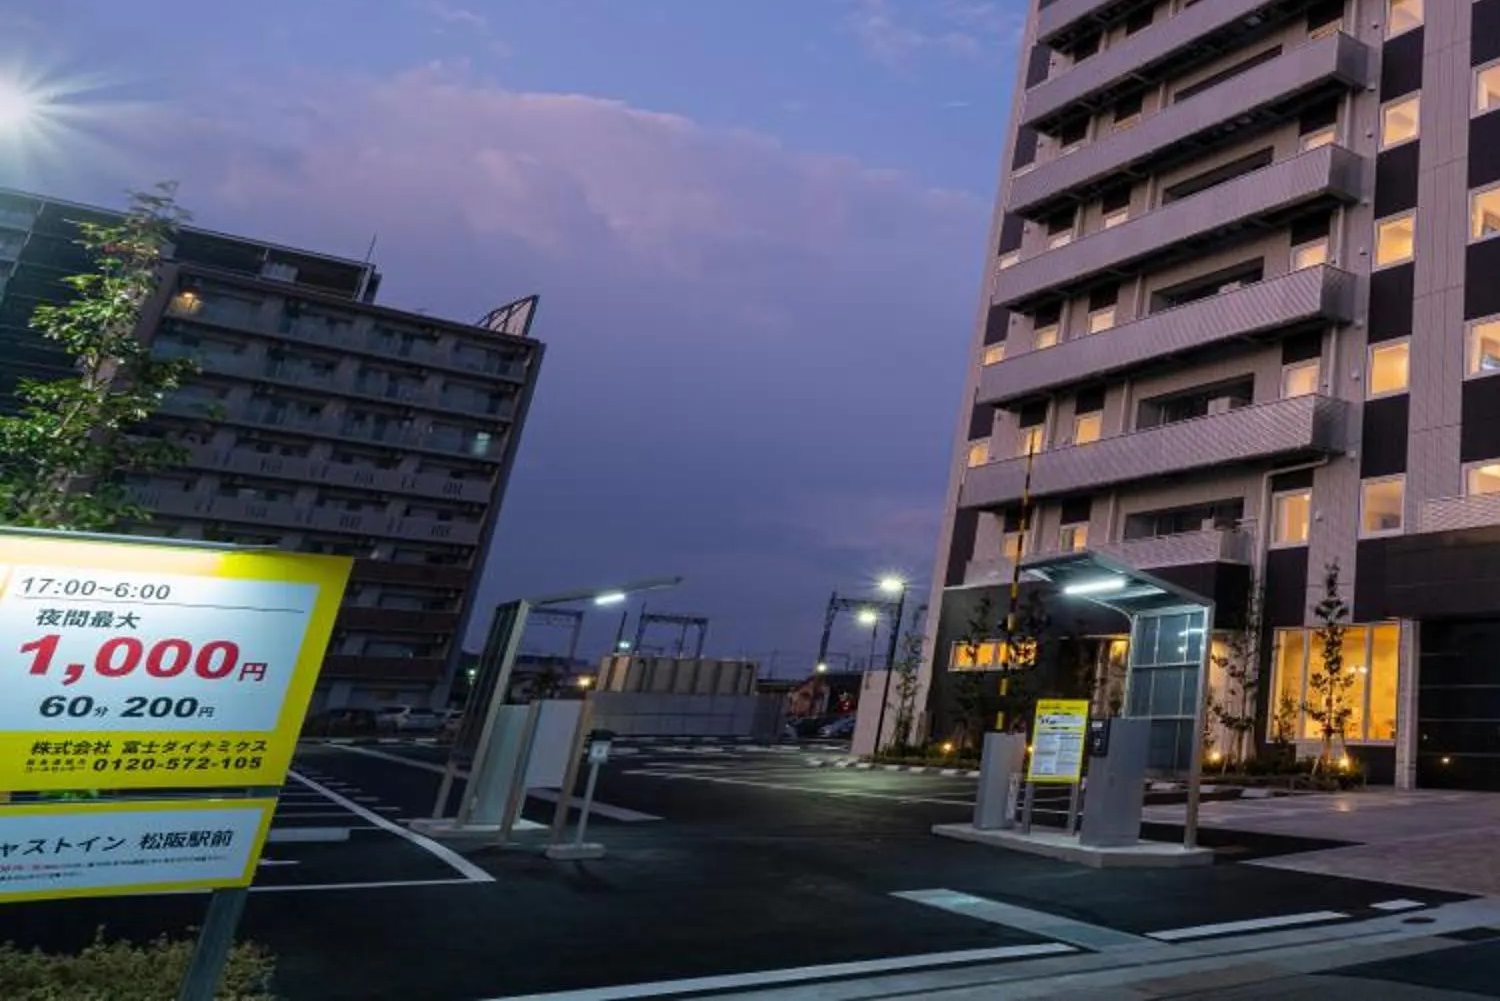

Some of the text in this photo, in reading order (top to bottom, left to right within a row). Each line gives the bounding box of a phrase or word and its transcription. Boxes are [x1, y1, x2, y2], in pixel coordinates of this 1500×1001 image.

[36, 607, 141, 629] 夜間最大
[20, 634, 268, 686] 1,000円
[39, 695, 215, 719] 60分 200円
[30, 739, 267, 756] 株式会社 富士ダイナミクス
[92, 756, 262, 771] 0120-572-105
[140, 830, 234, 850] 松阪駅前
